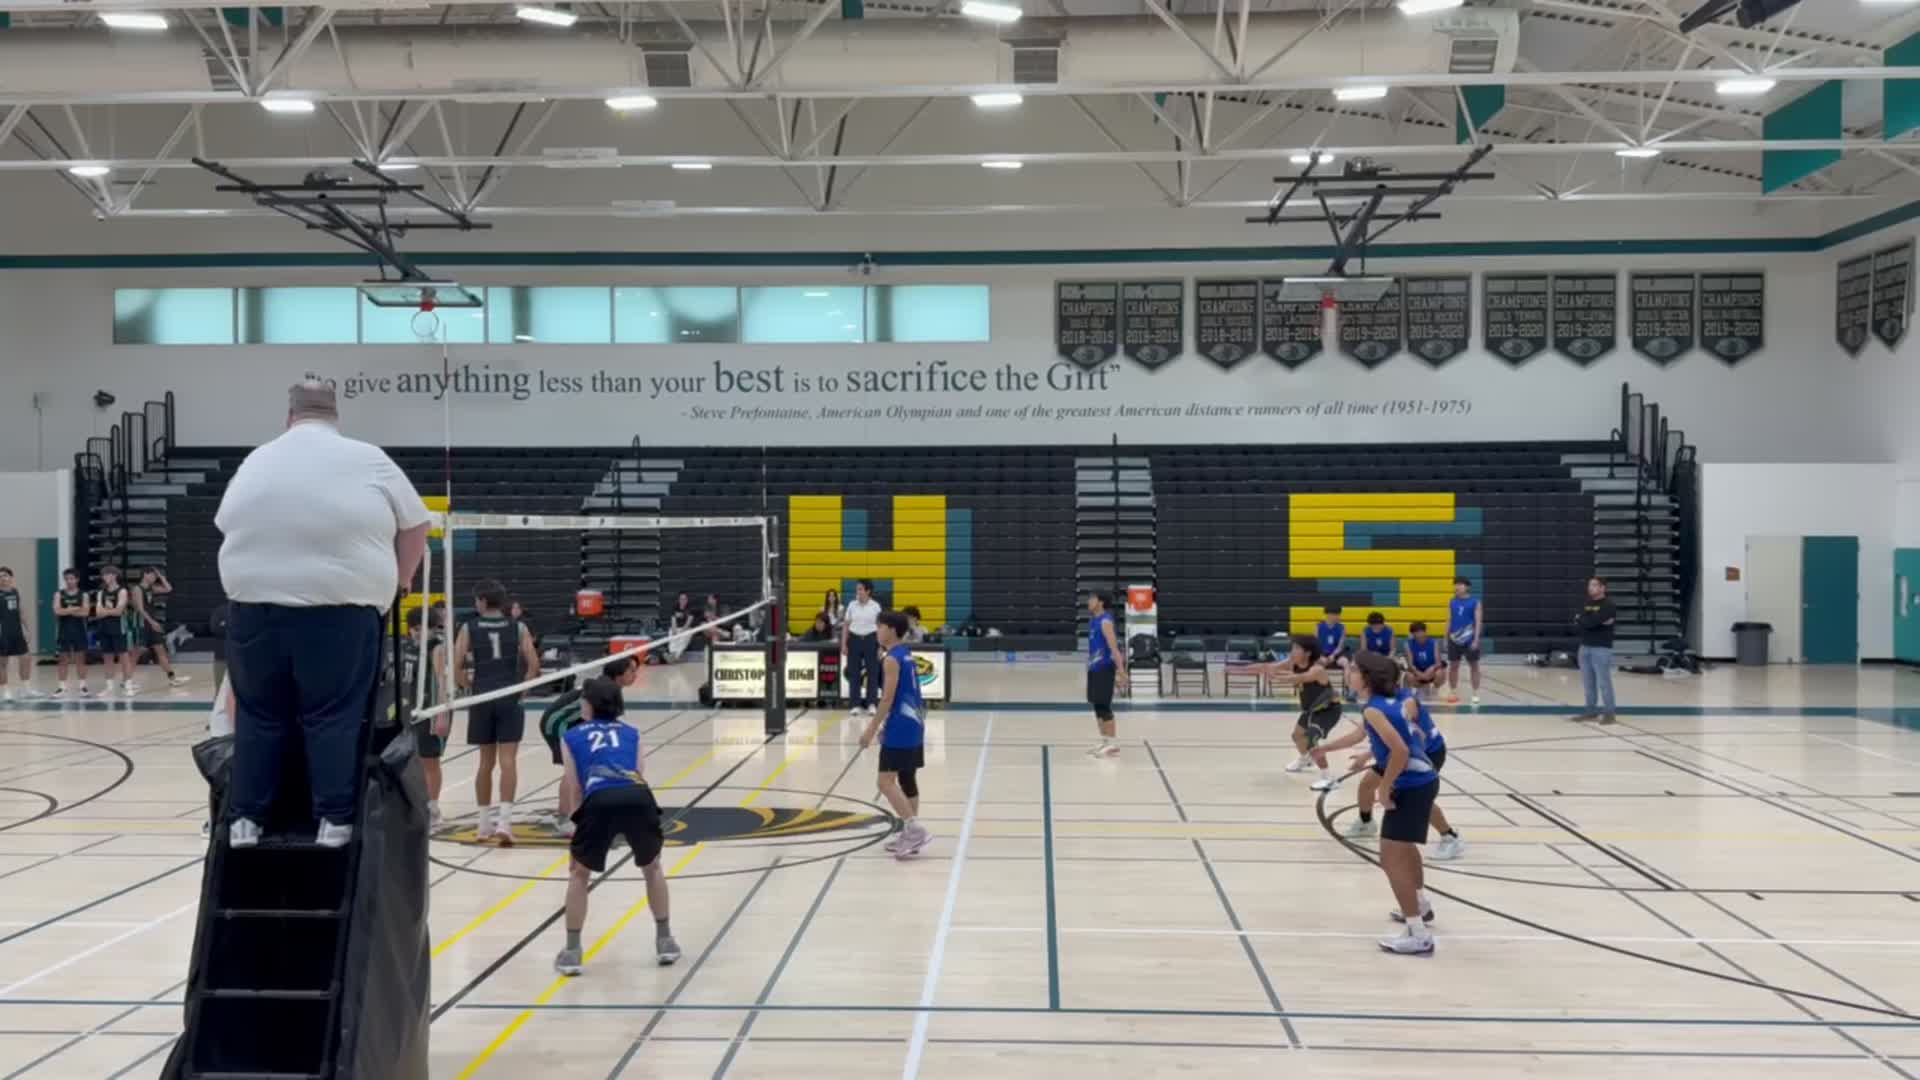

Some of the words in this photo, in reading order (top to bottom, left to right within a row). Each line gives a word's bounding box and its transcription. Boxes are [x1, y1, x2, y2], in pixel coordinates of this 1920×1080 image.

[344, 372, 391, 399] give
[397, 364, 531, 400] anything
[539, 370, 583, 393] less
[592, 370, 642, 393] than
[650, 375, 706, 400] your
[714, 360, 784, 393] best
[794, 372, 811, 392] is
[818, 376, 840, 392] to
[846, 360, 987, 393] sacrifice
[995, 363, 1039, 391] the
[690, 406, 727, 419] Steve
[816, 405, 882, 419] American
[886, 404, 953, 421] Olympian
[956, 404, 983, 418] and
[985, 406, 1011, 418] one
[1014, 403, 1031, 421] of
[1031, 403, 1053, 418] the
[1056, 405, 1111, 420] greatest
[1114, 403, 1182, 417] American
[1184, 402, 1246, 417] distance
[1247, 404, 1303, 417] runners
[1306, 401, 1321, 419] of
[1323, 400, 1344, 416] all
[1347, 400, 1380, 416] time
[1382, 399, 1473, 416] (1951-1975)
[789, 495, 947, 635] H
[1289, 493, 1456, 635] S
[488, 632, 501, 659] 1
[714, 668, 766, 682] CHRISTOP
[788, 668, 815, 681] HIGH
[587, 729, 619, 753] 21
